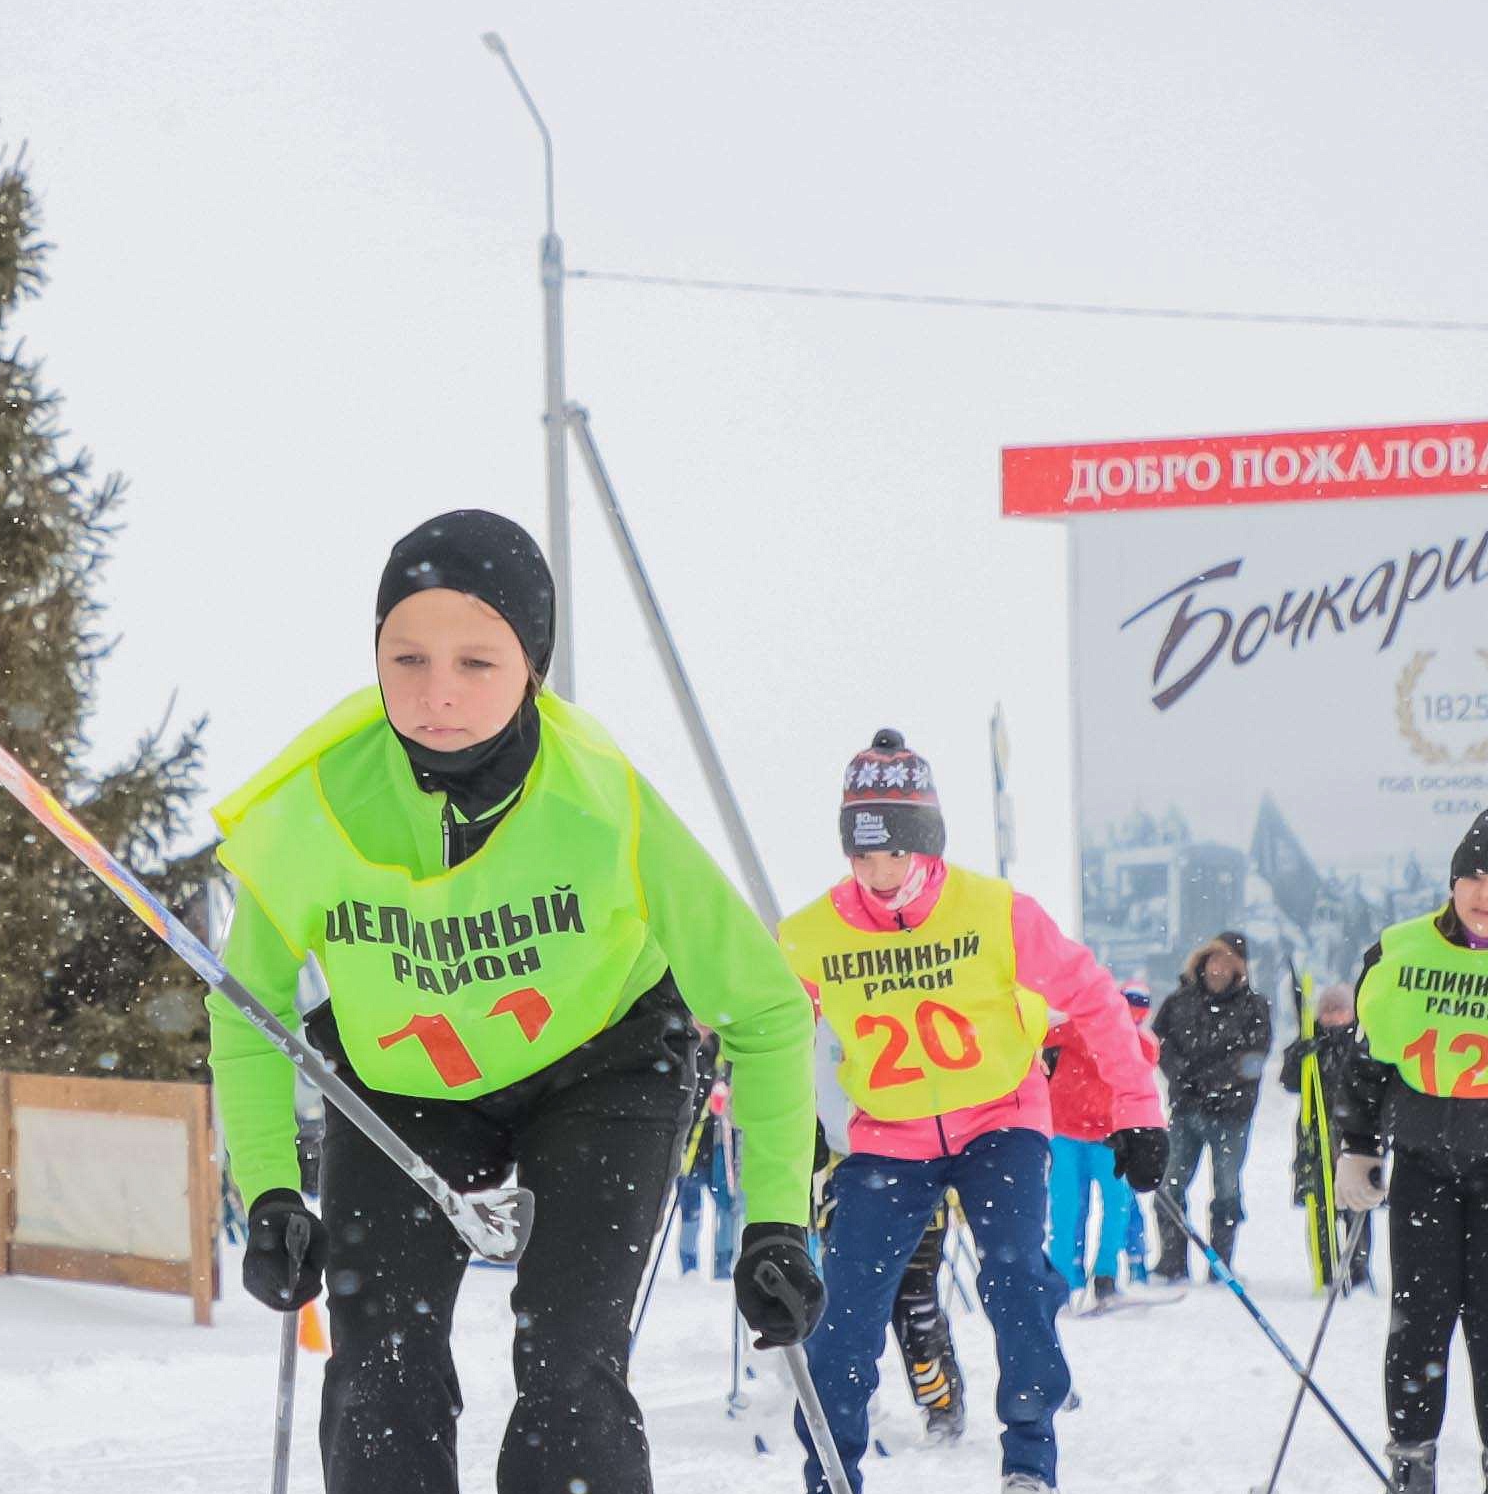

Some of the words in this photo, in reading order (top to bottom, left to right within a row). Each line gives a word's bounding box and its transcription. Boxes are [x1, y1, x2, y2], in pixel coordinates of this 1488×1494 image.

[1064, 451, 1222, 505] ДОБРО
[325, 884, 586, 962] ЦЕЛИННЫЙ
[392, 945, 542, 996] РАЙОН
[822, 931, 980, 985] ЦЕЛИННЫЙ
[863, 968, 954, 1001] РАЙОН
[855, 1000, 983, 1090] 20
